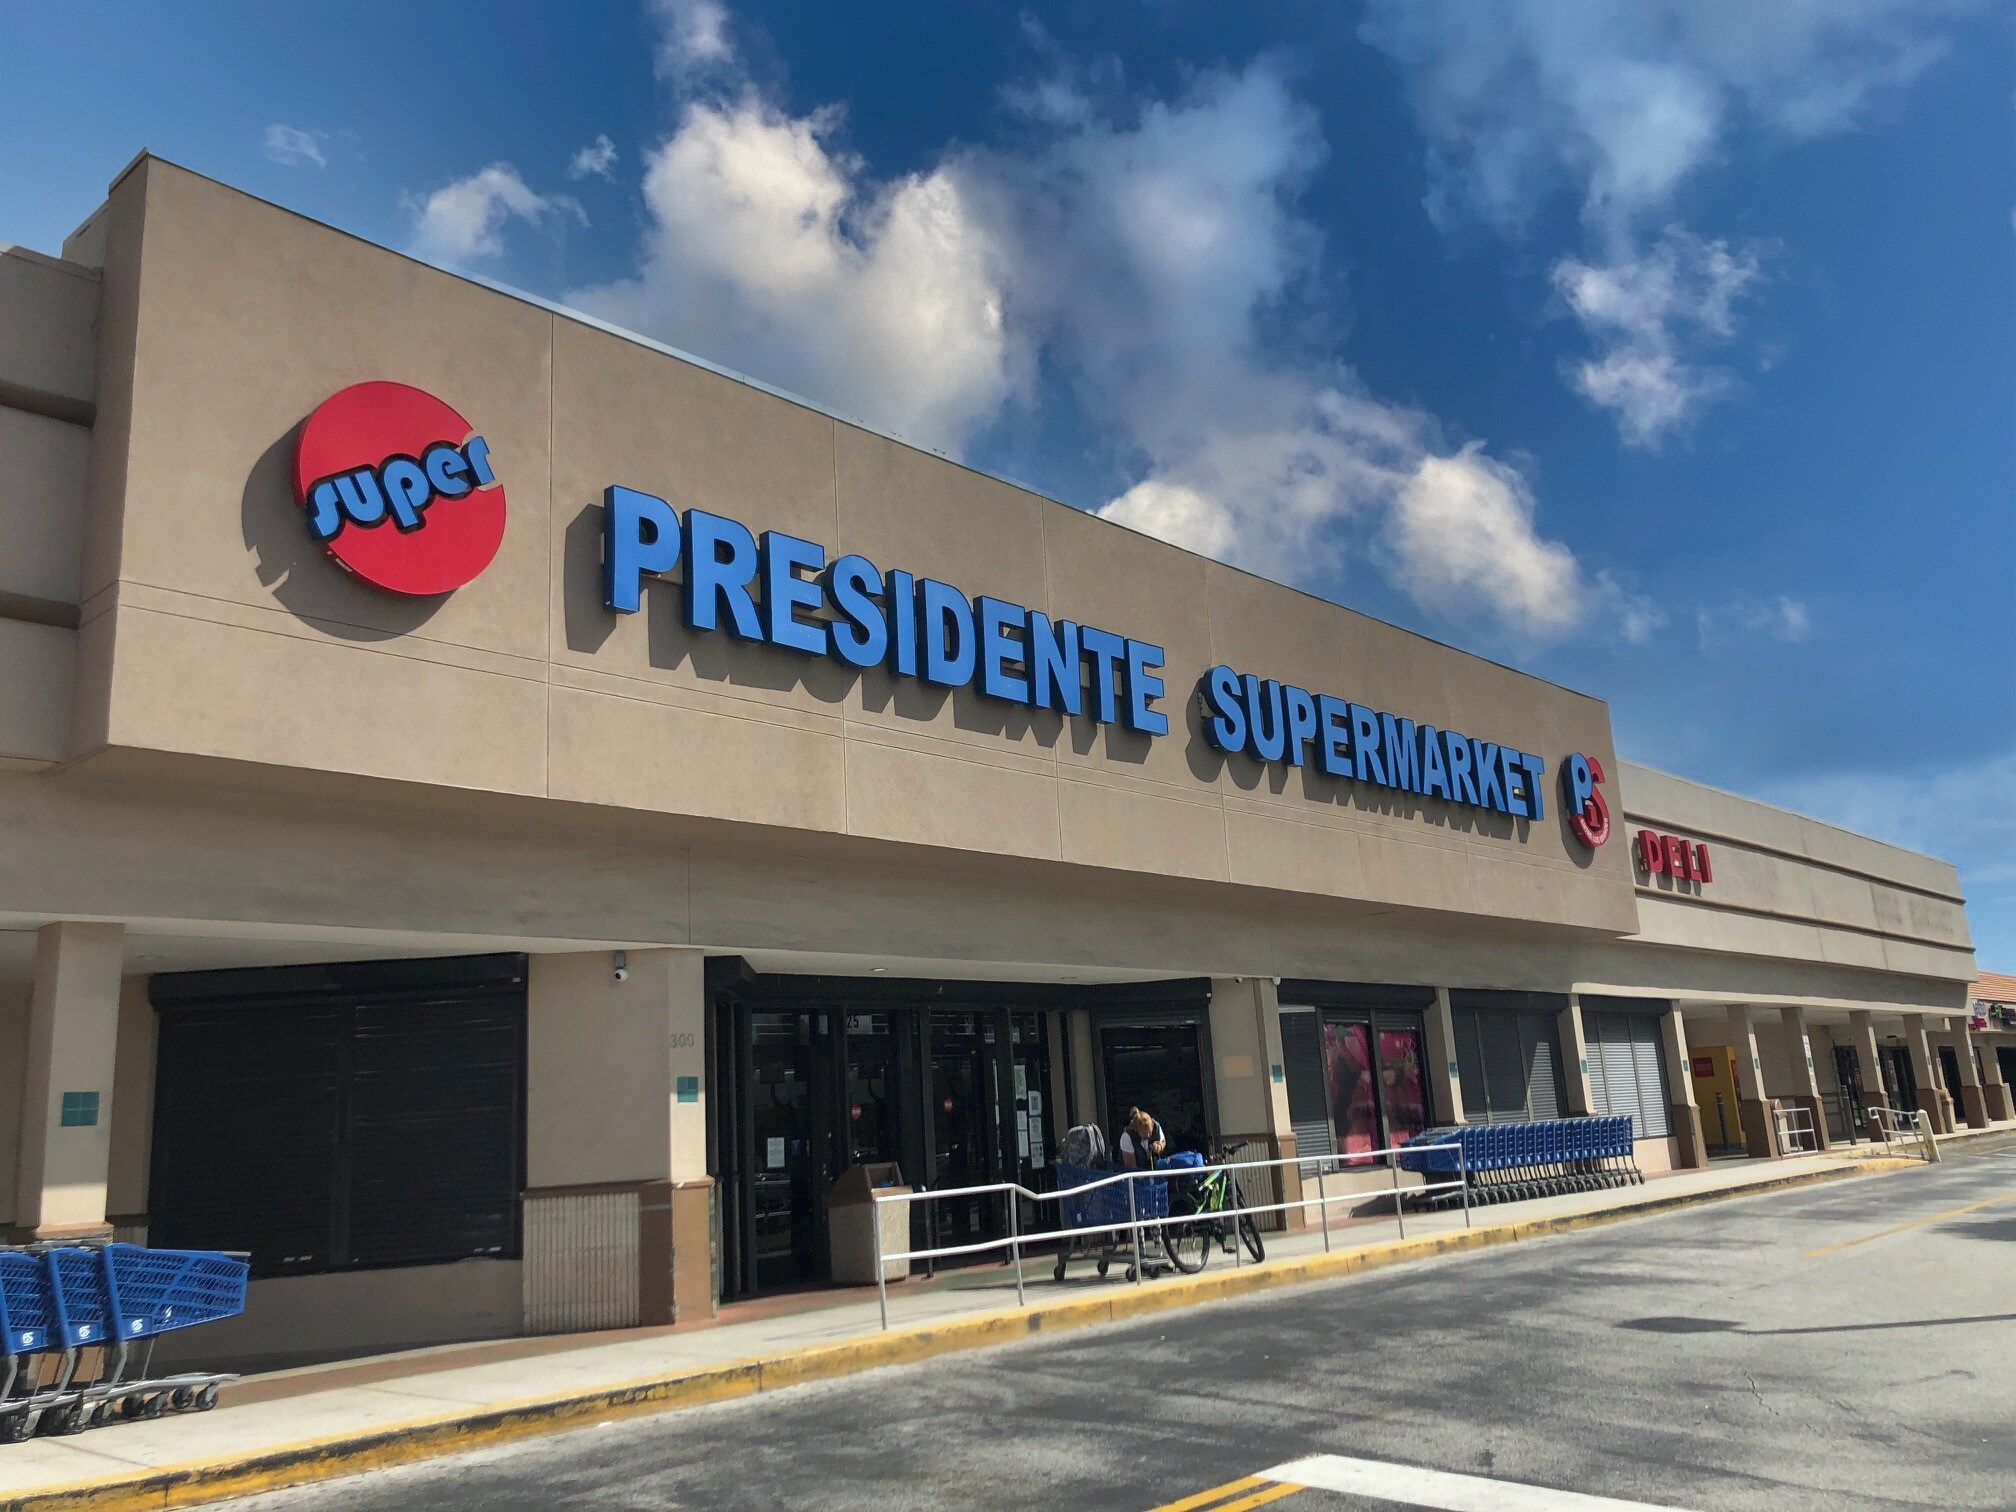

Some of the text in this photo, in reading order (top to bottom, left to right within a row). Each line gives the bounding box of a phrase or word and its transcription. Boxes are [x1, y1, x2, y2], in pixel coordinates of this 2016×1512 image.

[604, 485, 1544, 821] PRESIDENTE SUPERMARKET
[1638, 830, 1713, 883] DELI
[670, 1033, 695, 1048] 300
